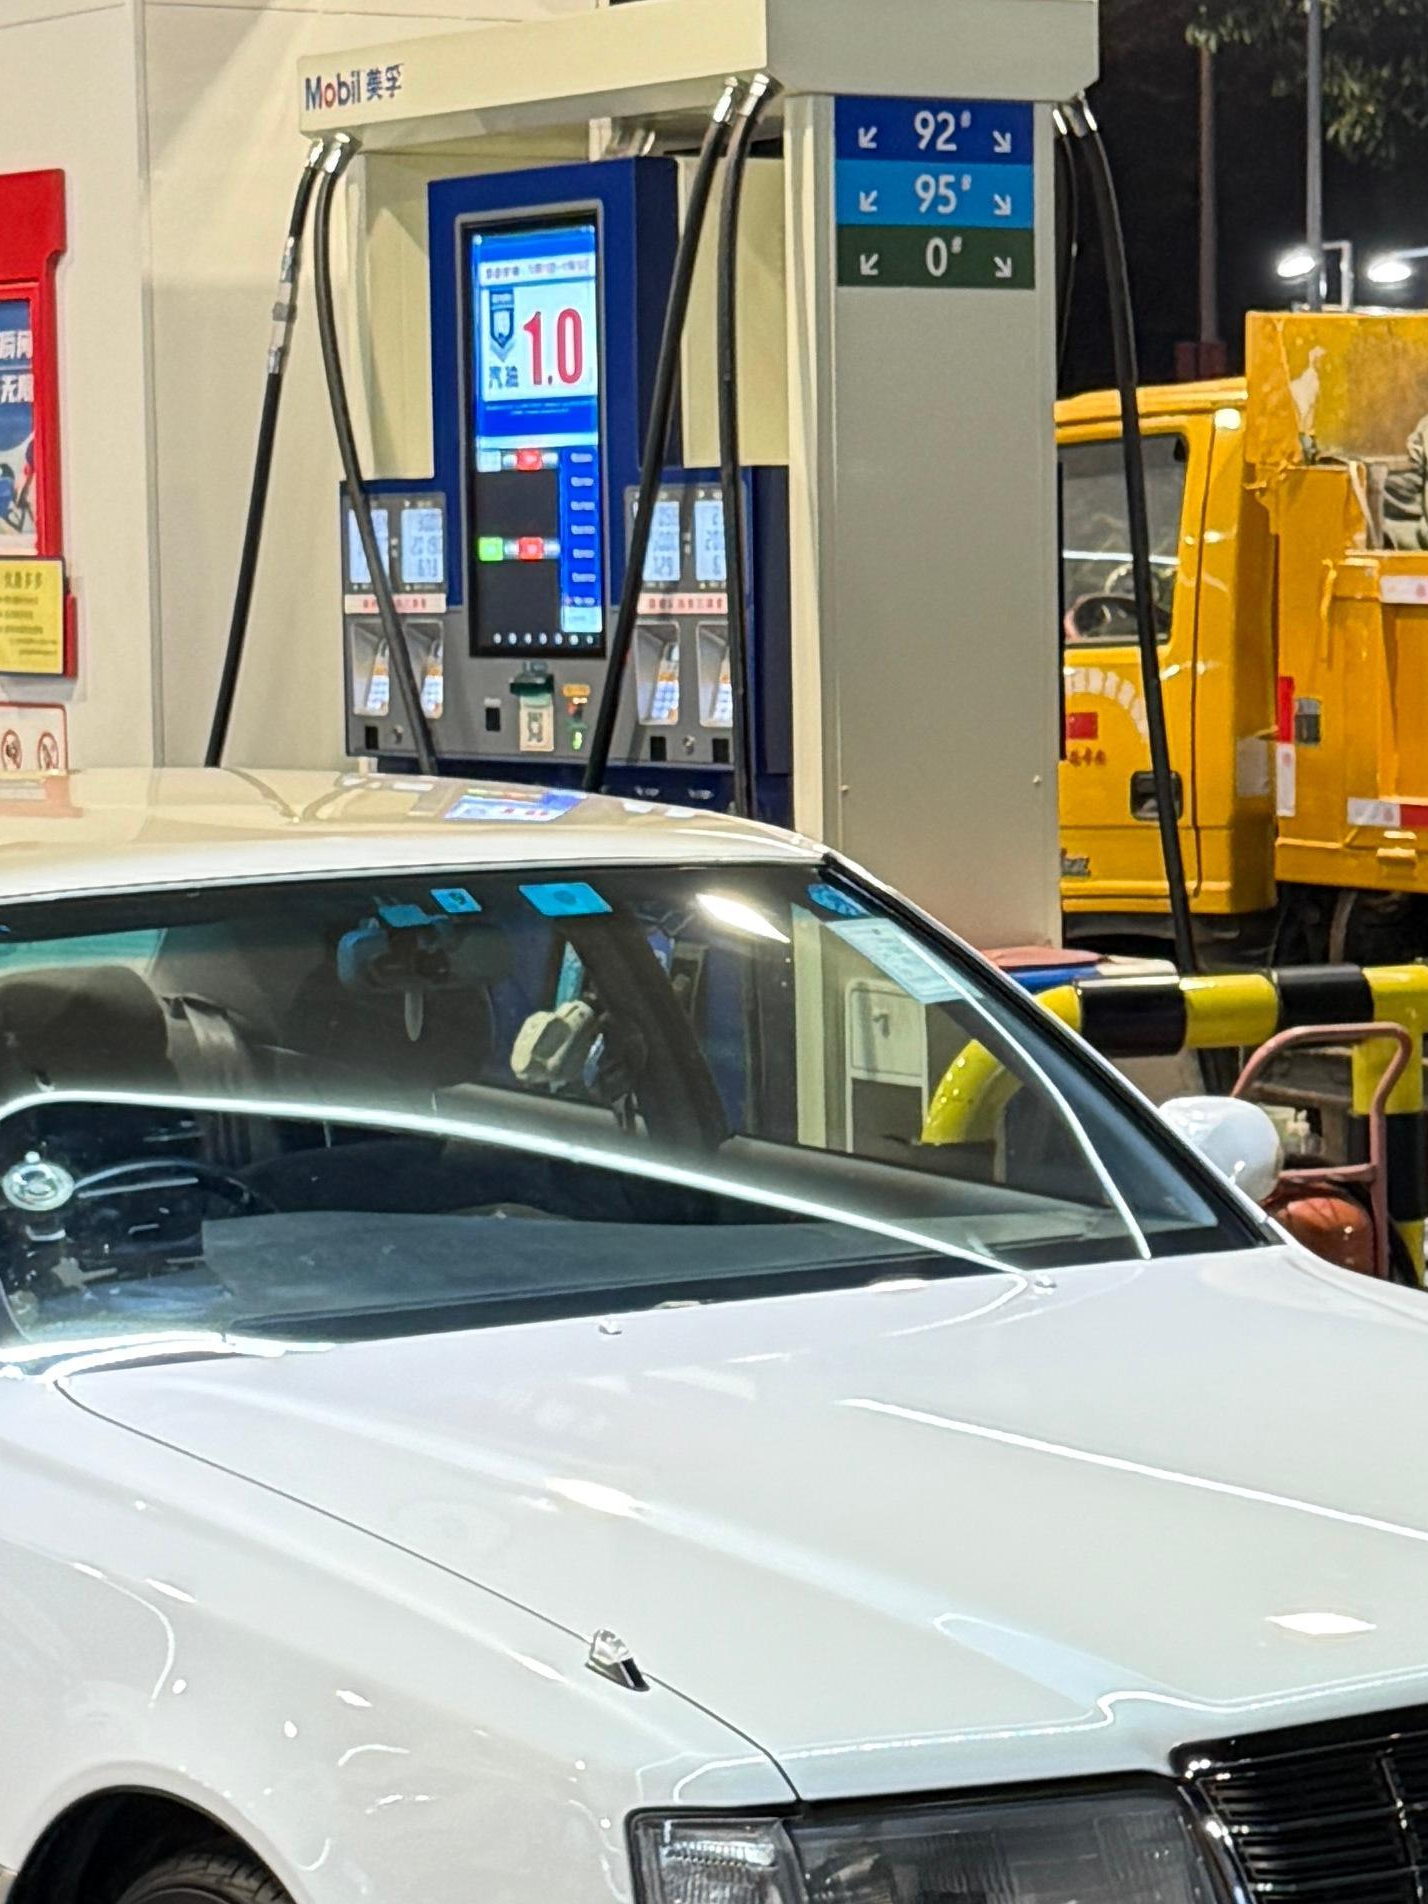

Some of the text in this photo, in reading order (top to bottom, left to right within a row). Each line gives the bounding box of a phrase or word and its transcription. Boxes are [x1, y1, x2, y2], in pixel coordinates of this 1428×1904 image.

[305, 63, 404, 111] Mobil 美孚
[523, 307, 583, 386] 1.0
